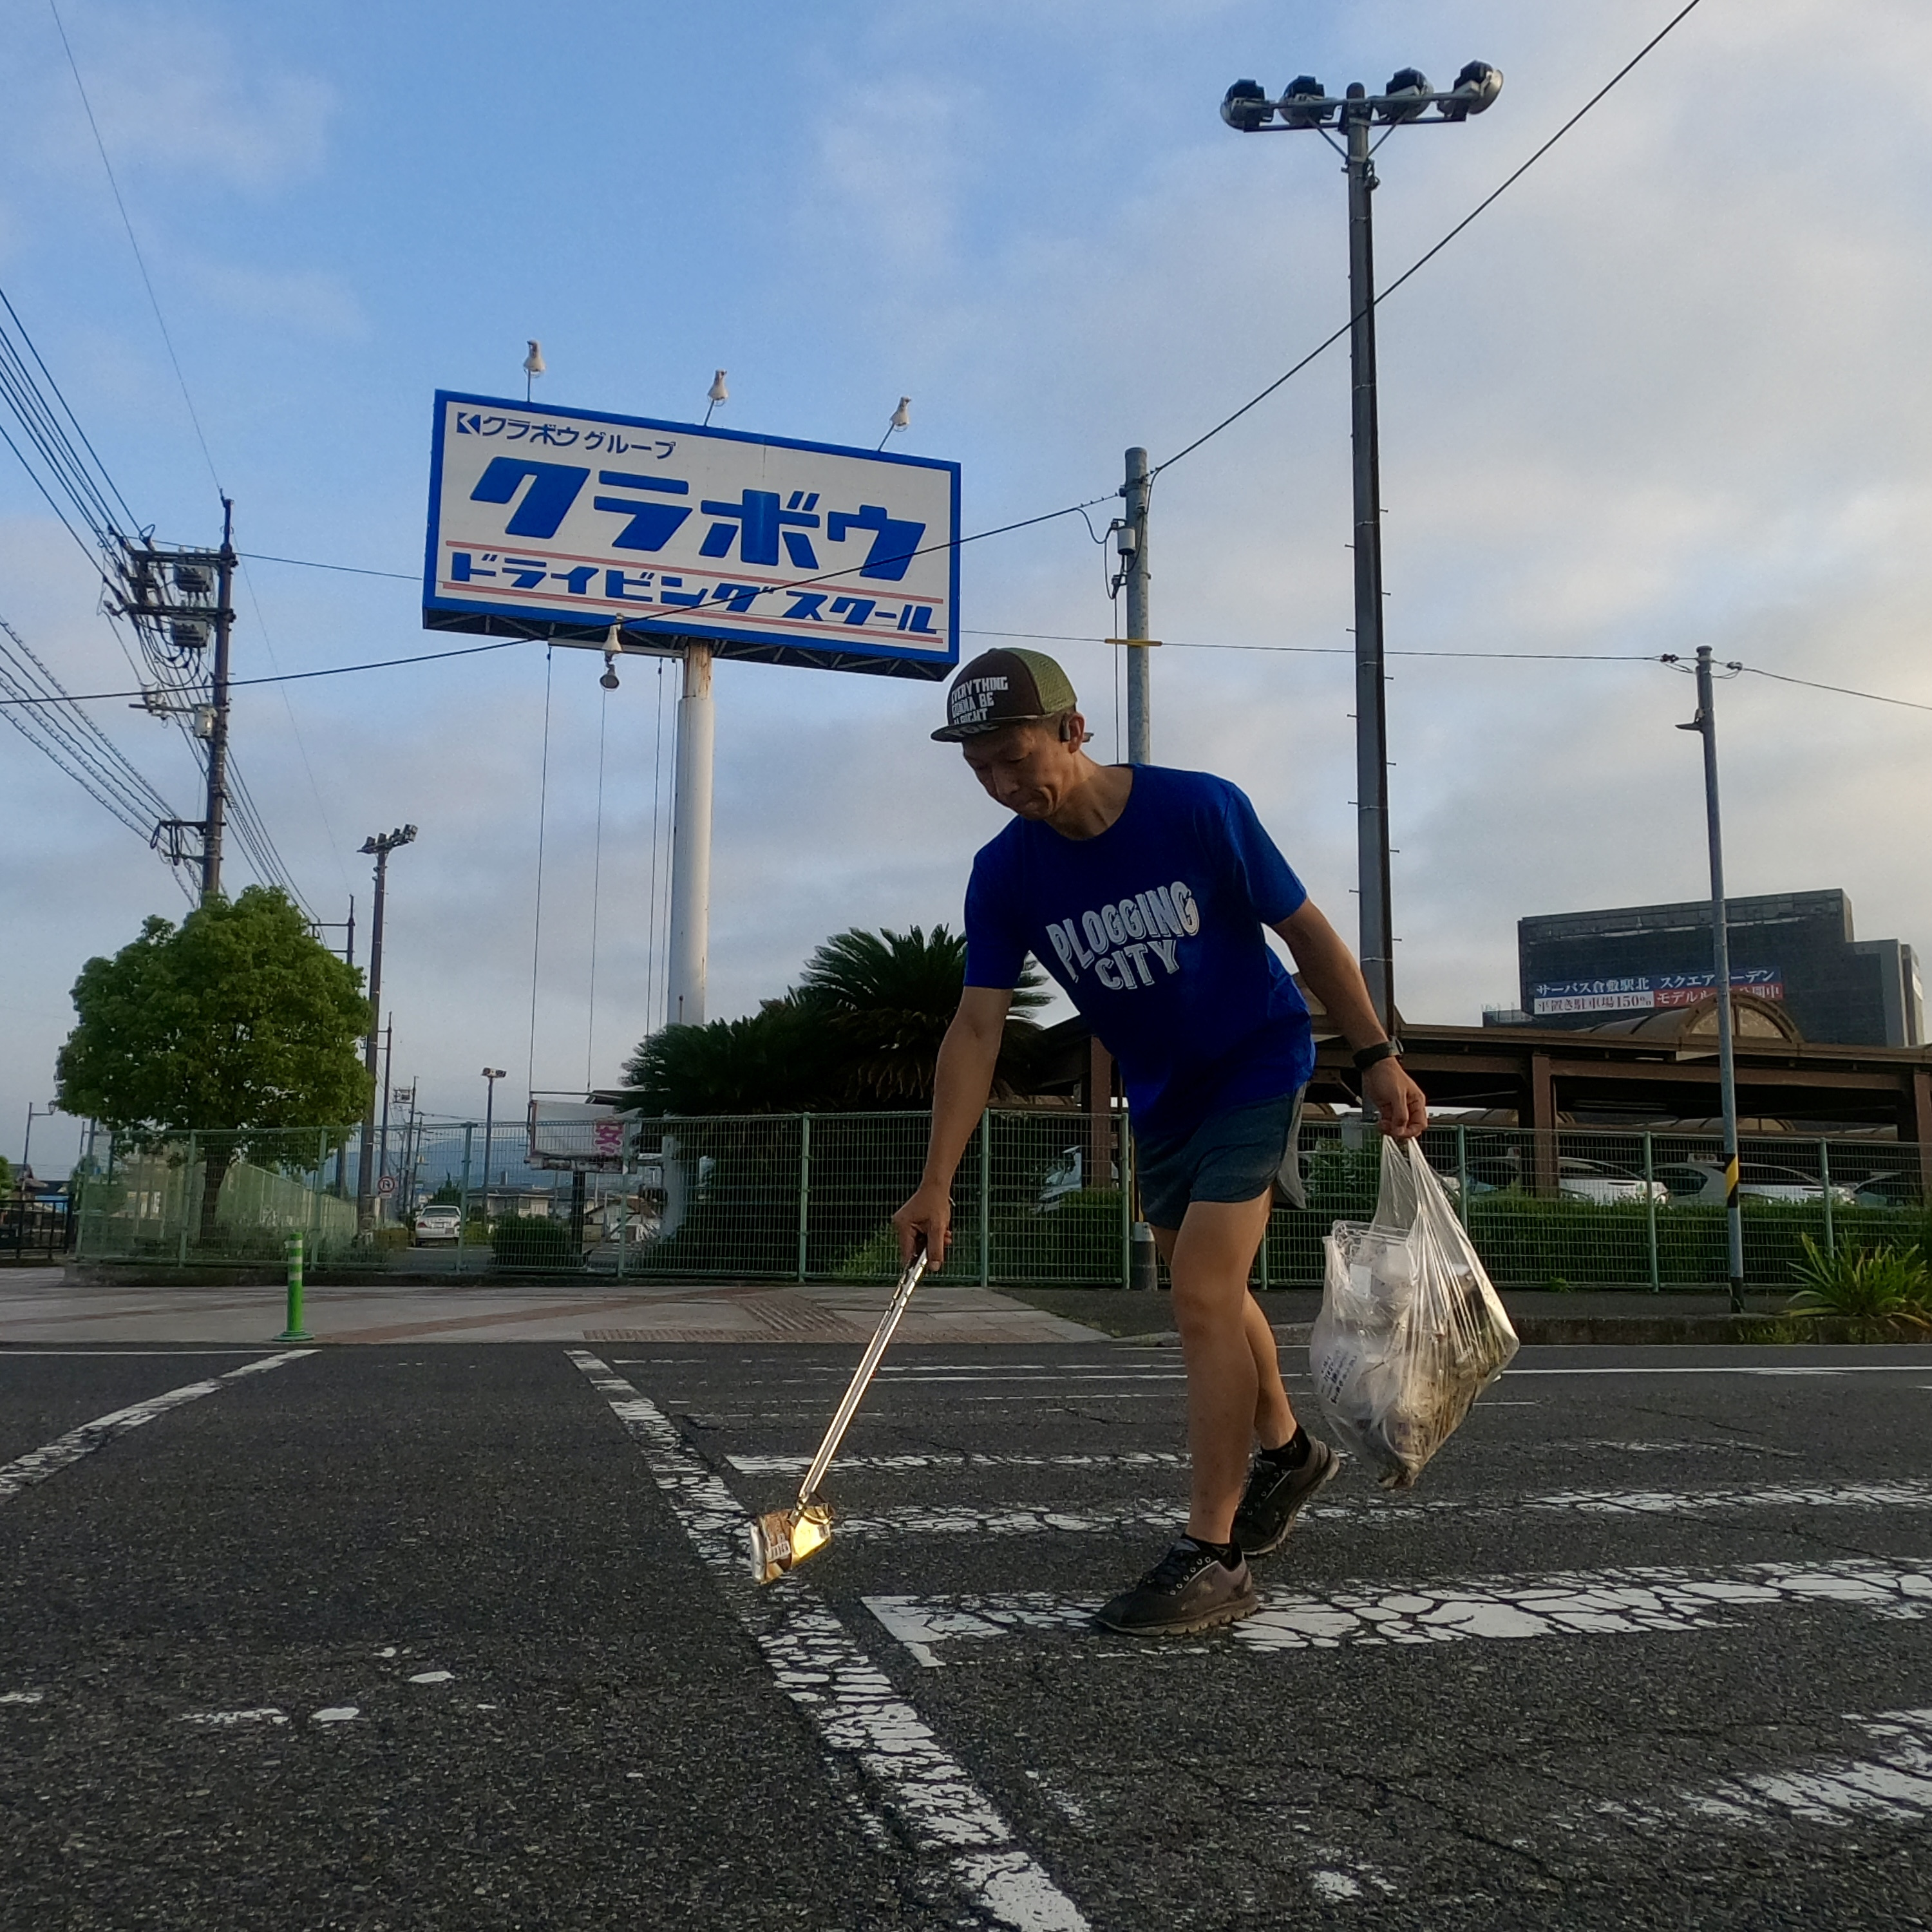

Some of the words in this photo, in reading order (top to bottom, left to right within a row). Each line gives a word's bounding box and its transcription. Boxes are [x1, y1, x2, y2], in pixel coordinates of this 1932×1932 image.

[470, 456, 925, 581] クラボウ
[952, 676, 1009, 704] EVERYTHING
[979, 692, 994, 708] BE
[1045, 881, 1199, 983] PLOGGING
[1095, 940, 1179, 990] CITY
[1660, 971, 1774, 989] スクエアーデン
